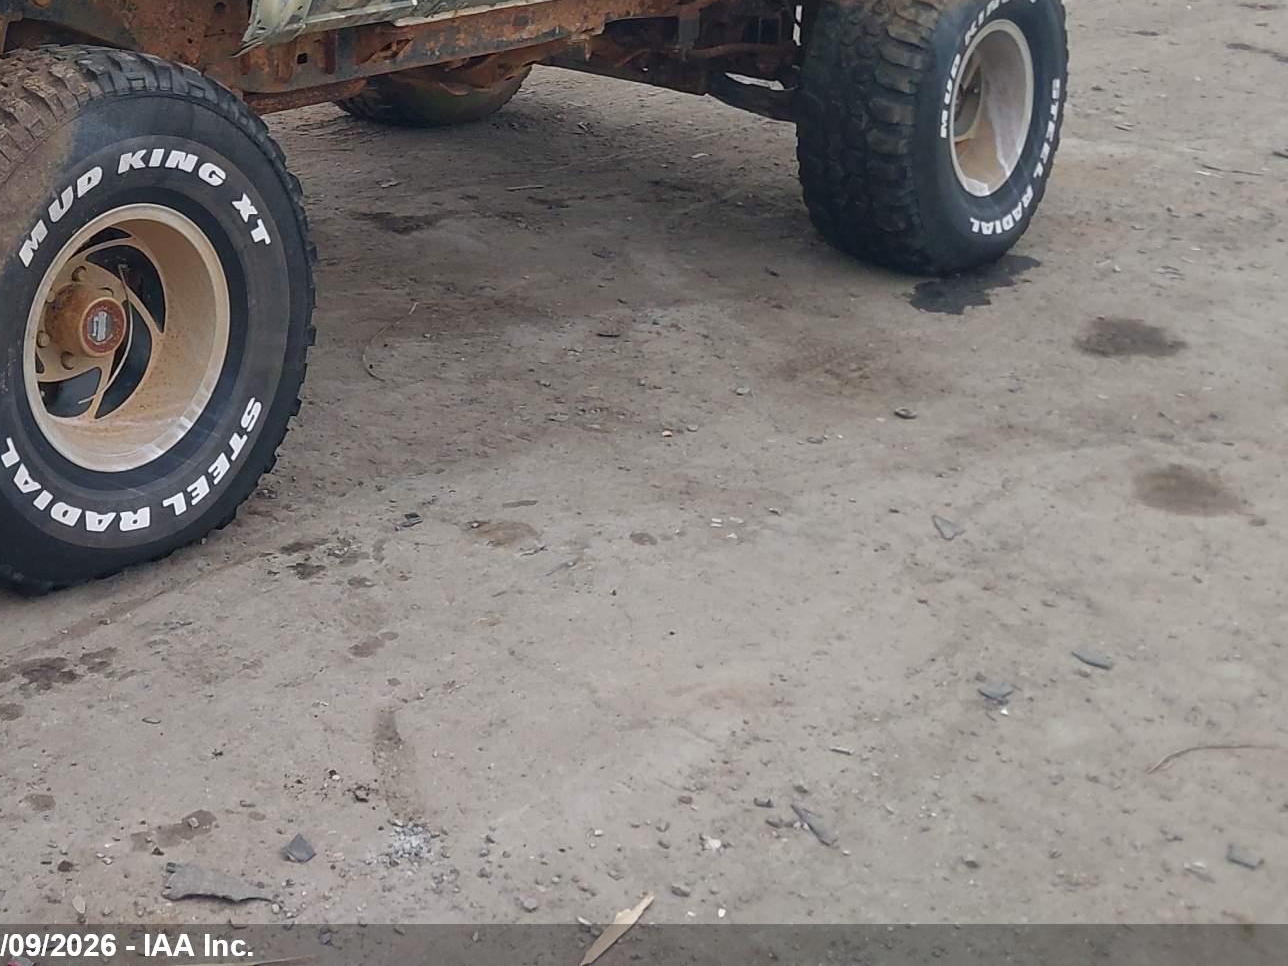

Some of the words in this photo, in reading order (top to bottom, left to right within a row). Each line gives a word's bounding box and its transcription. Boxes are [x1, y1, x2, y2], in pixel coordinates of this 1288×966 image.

[940, 54, 961, 138] MUD
[1032, 78, 1061, 179] STEEL
[18, 165, 103, 267] MUD
[118, 148, 226, 187] KING
[231, 193, 272, 246] XT
[969, 185, 1034, 235] RADIAL
[0, 436, 151, 533] RADIAL
[162, 396, 263, 517] STEEL
